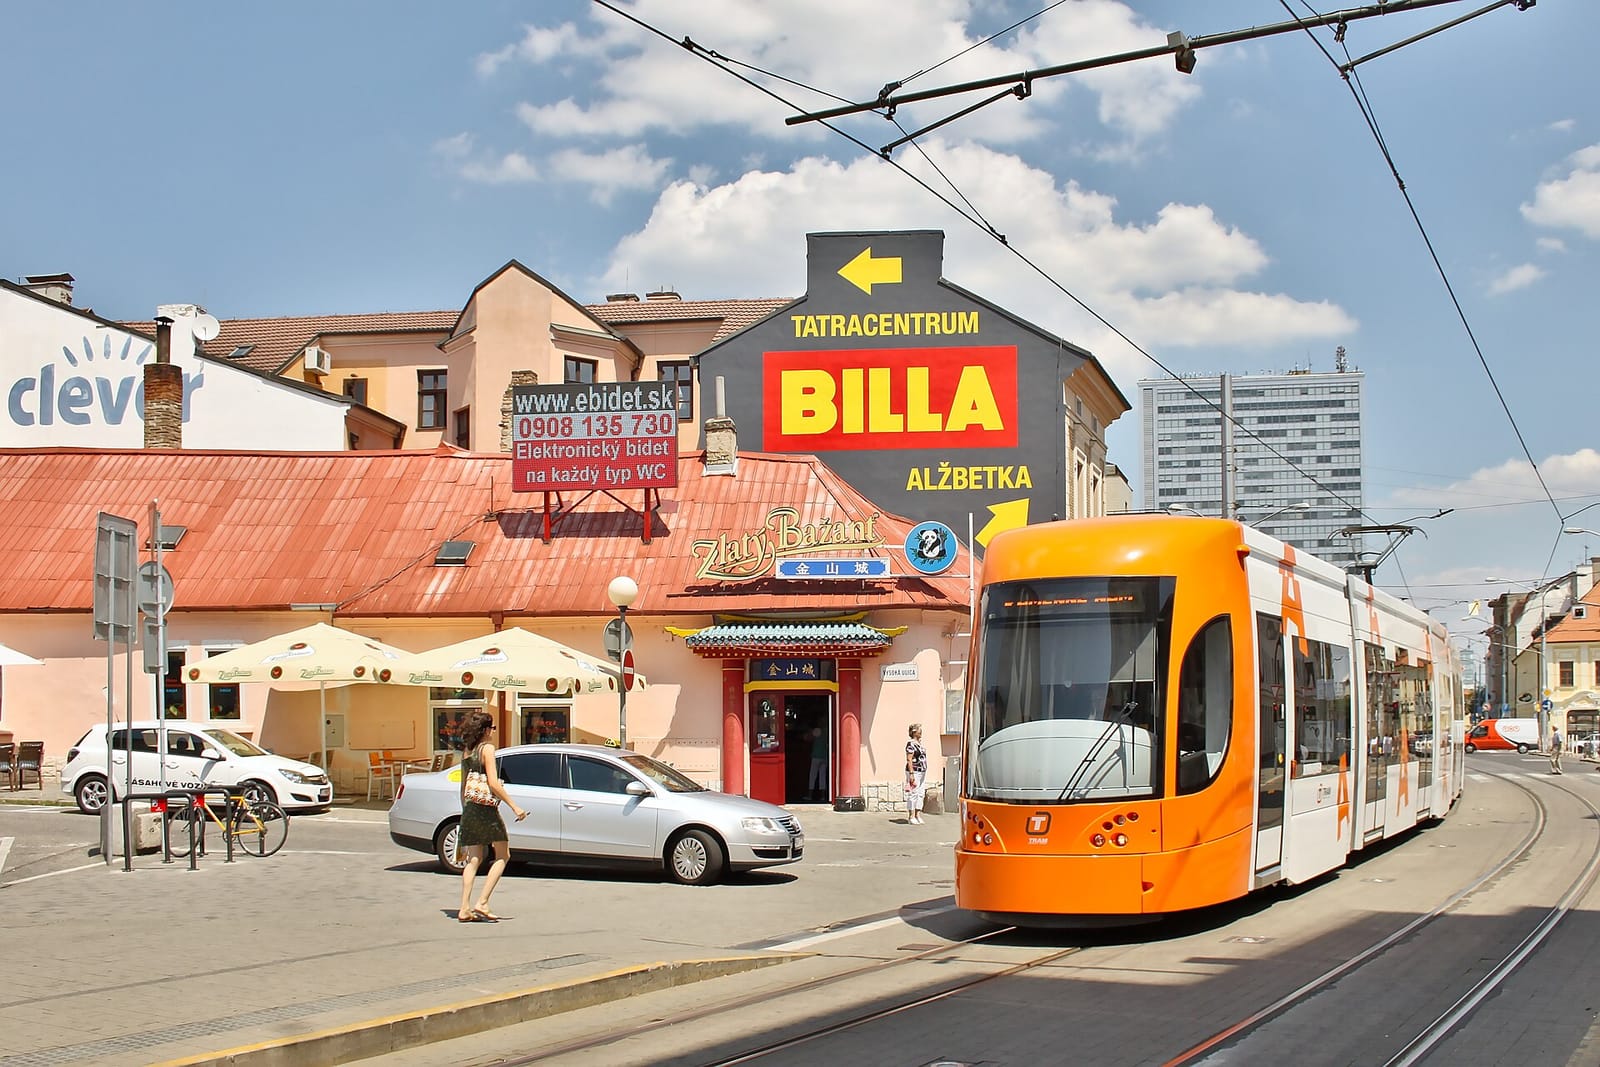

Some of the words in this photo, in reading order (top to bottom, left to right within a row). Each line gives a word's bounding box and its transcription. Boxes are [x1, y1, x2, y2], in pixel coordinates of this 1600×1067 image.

[791, 311, 979, 338] TATRACENTRUM
[8, 363, 205, 426] clevr
[515, 384, 674, 413] www.ebidet.sk
[780, 365, 1005, 435] BILLA
[519, 416, 573, 438] 0908
[582, 415, 623, 437] 135
[631, 413, 673, 436] 730
[516, 441, 620, 460] Elektronický
[626, 439, 669, 456] bidet
[526, 469, 546, 483] na
[552, 465, 600, 485] každý
[605, 466, 632, 484] typ
[636, 463, 666, 480] WC
[906, 461, 1033, 491] ALŽBETKA
[691, 527, 776, 580] Zlatý
[795, 561, 870, 576] 金山城
[767, 661, 816, 678] 金山城
[1031, 816, 1047, 831] T
[1028, 837, 1049, 845] TRAM
